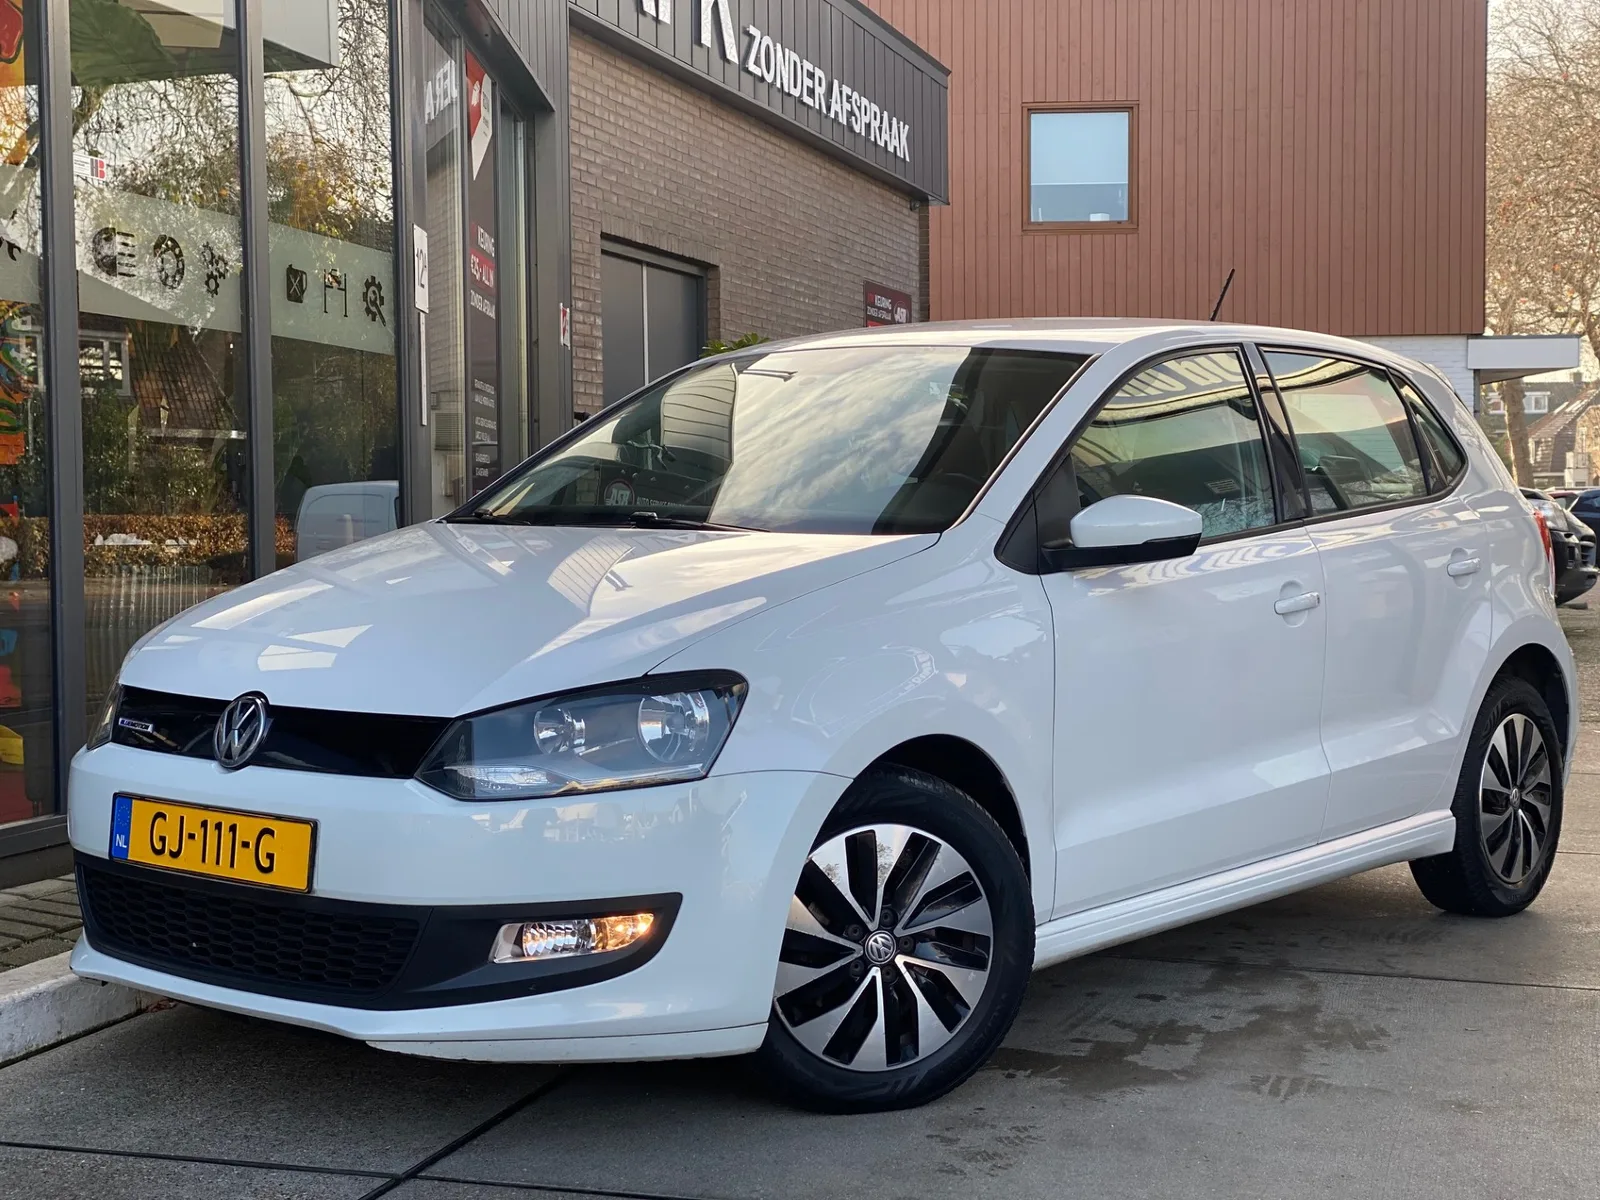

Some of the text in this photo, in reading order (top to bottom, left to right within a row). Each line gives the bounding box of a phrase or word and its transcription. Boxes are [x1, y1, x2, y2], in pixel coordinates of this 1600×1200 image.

[747, 24, 828, 115] ZONDER
[829, 78, 911, 162] AFSPRAAK
[115, 811, 277, 874] NL GJ-111-G
